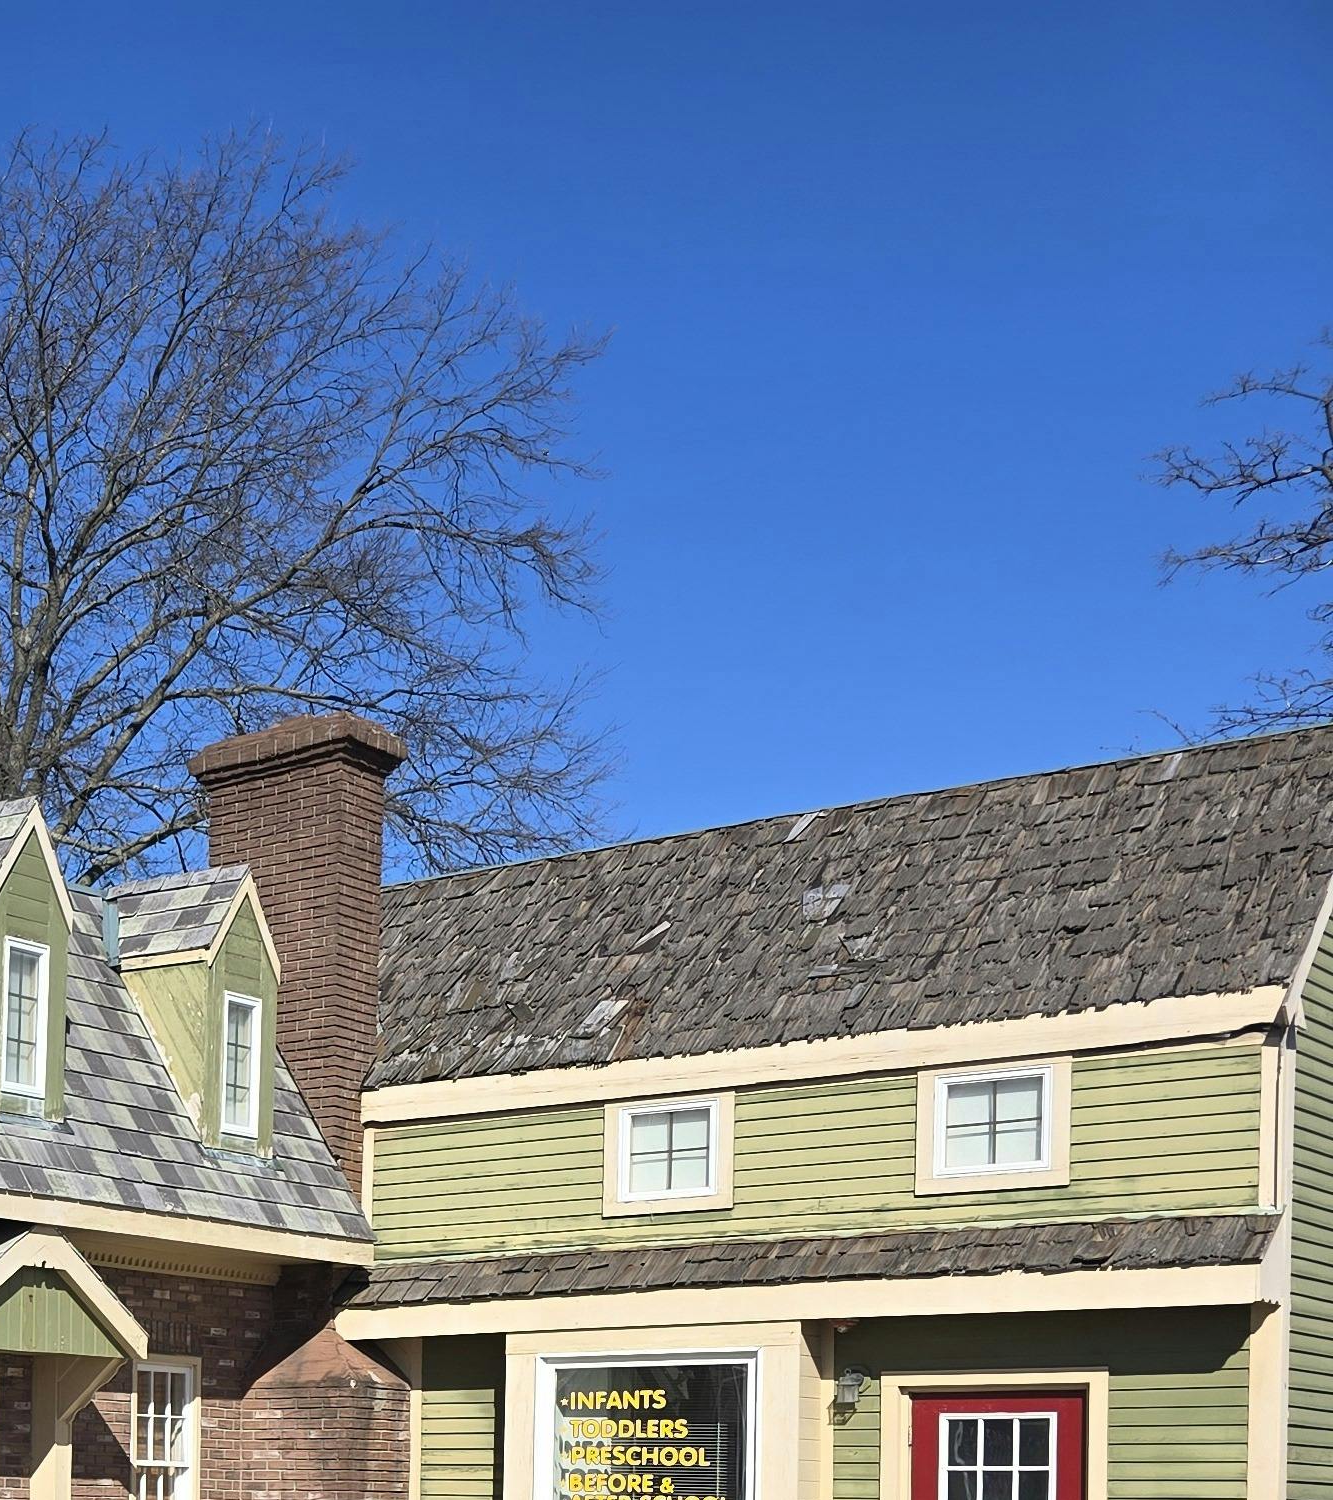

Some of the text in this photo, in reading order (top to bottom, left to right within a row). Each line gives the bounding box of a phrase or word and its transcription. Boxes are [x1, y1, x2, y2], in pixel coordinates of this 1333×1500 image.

[570, 1389, 667, 1410] INFANTS
[569, 1419, 689, 1439] TODDLERS
[570, 1446, 711, 1467] PRESCHOOL
[568, 1473, 675, 1494] BEFORE &
